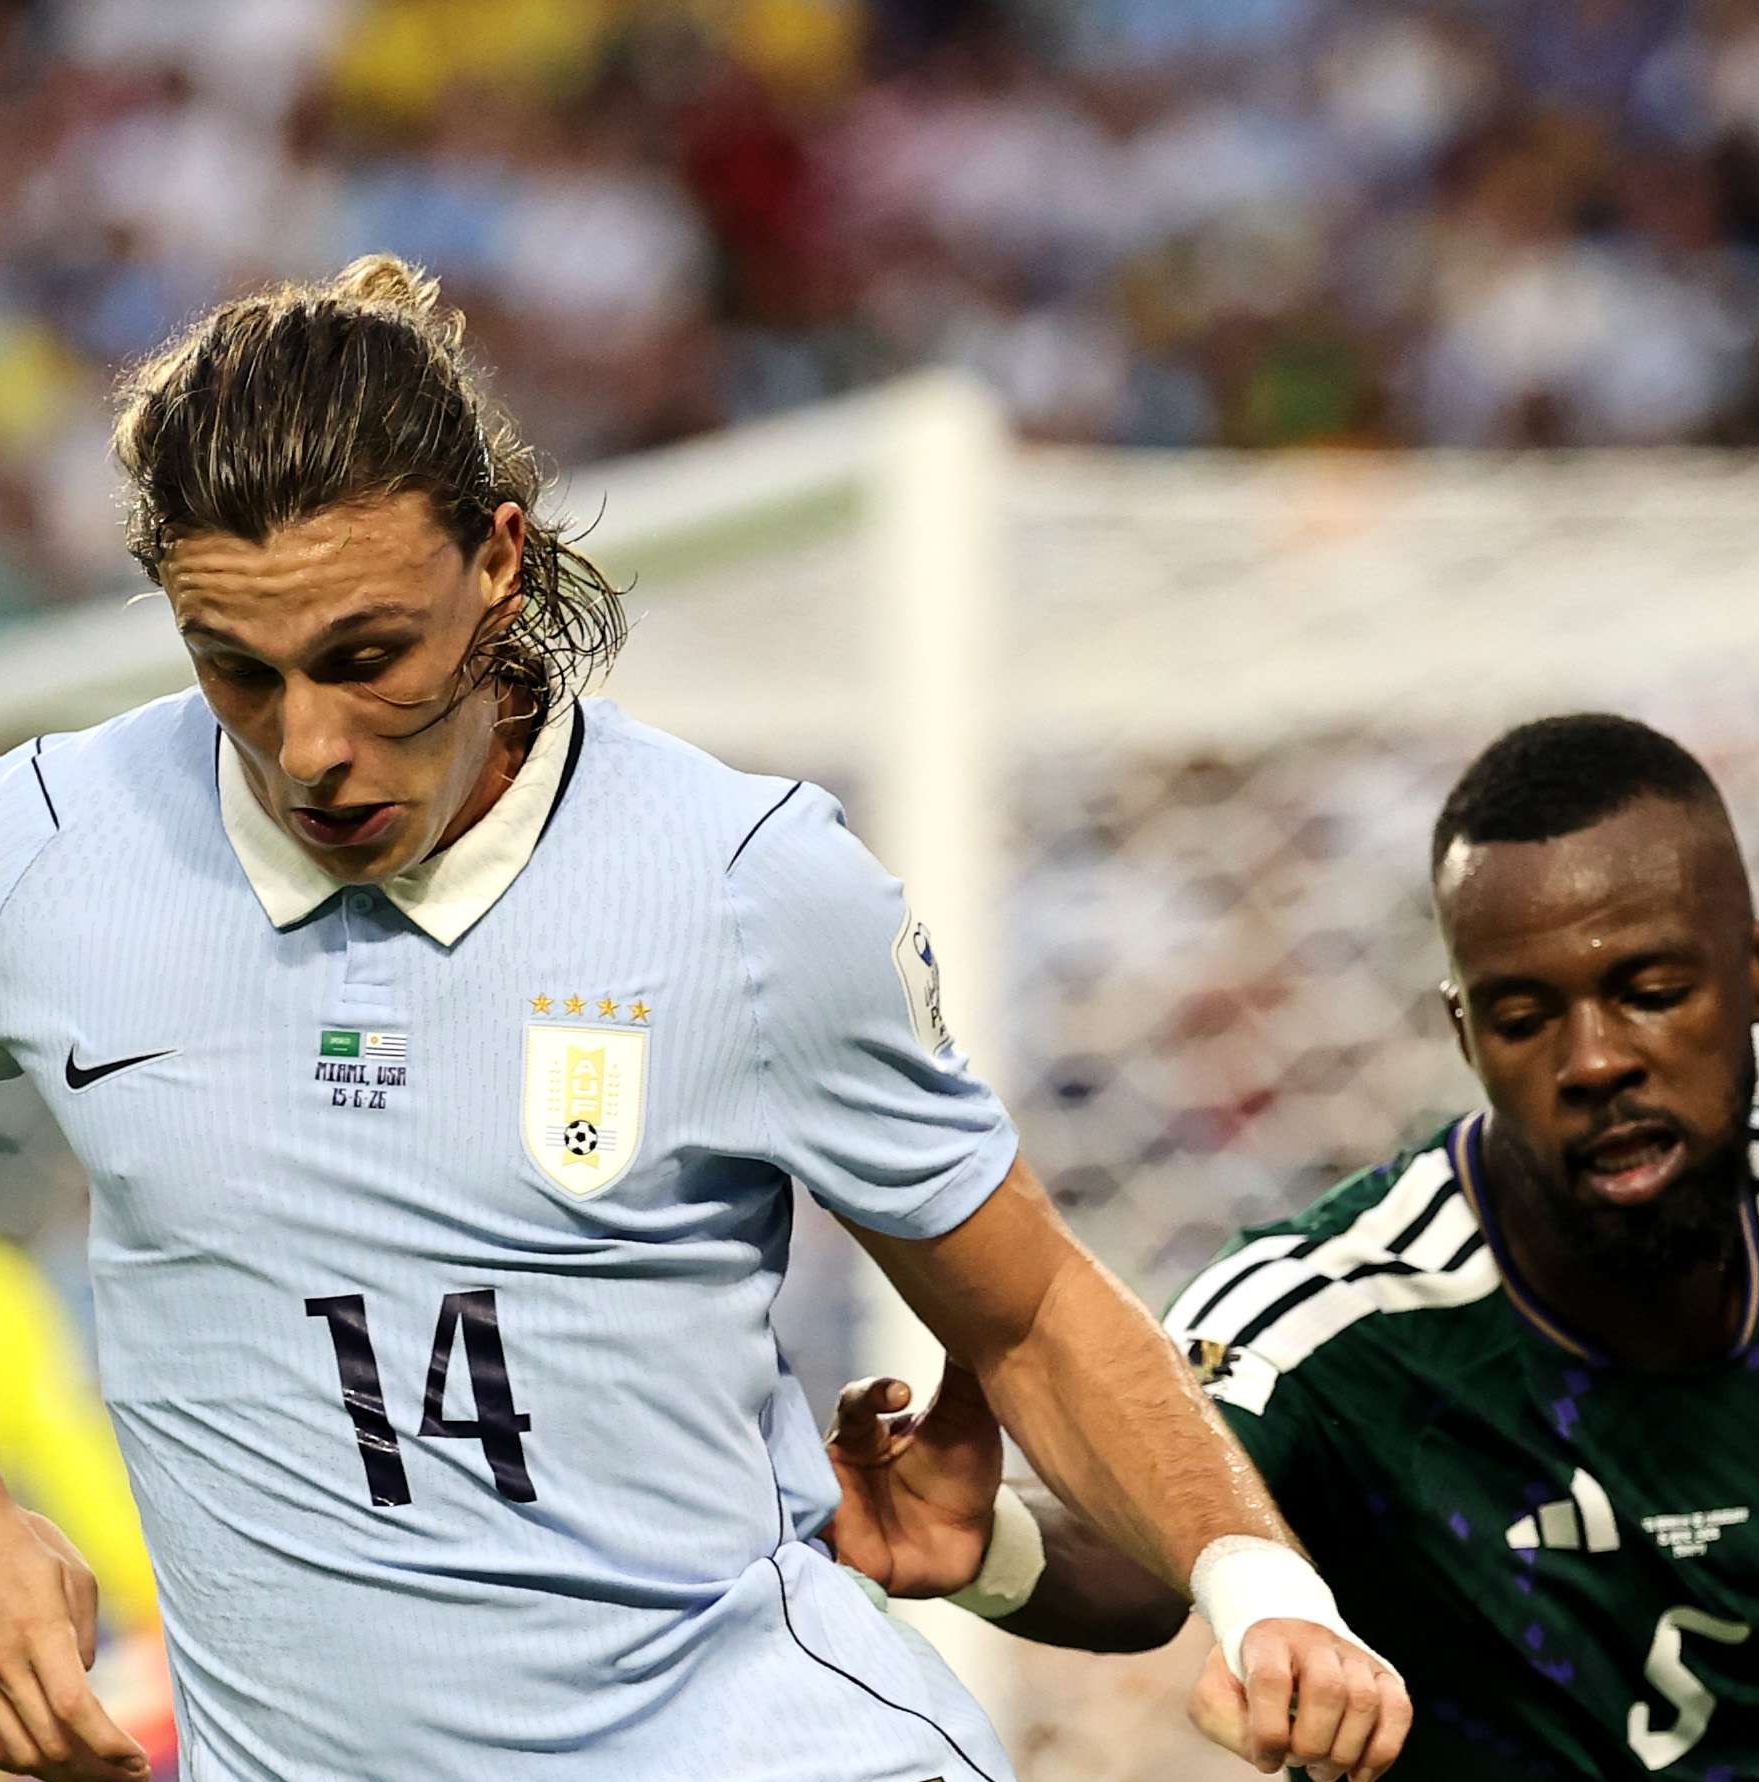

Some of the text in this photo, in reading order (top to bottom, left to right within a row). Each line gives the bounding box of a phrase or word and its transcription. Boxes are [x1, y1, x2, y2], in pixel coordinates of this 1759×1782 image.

[315, 1061, 407, 1086] MIAMI, USA
[570, 1057, 599, 1117] AUF
[304, 1289, 539, 1507] 14
[1627, 1604, 1751, 1772] 5
